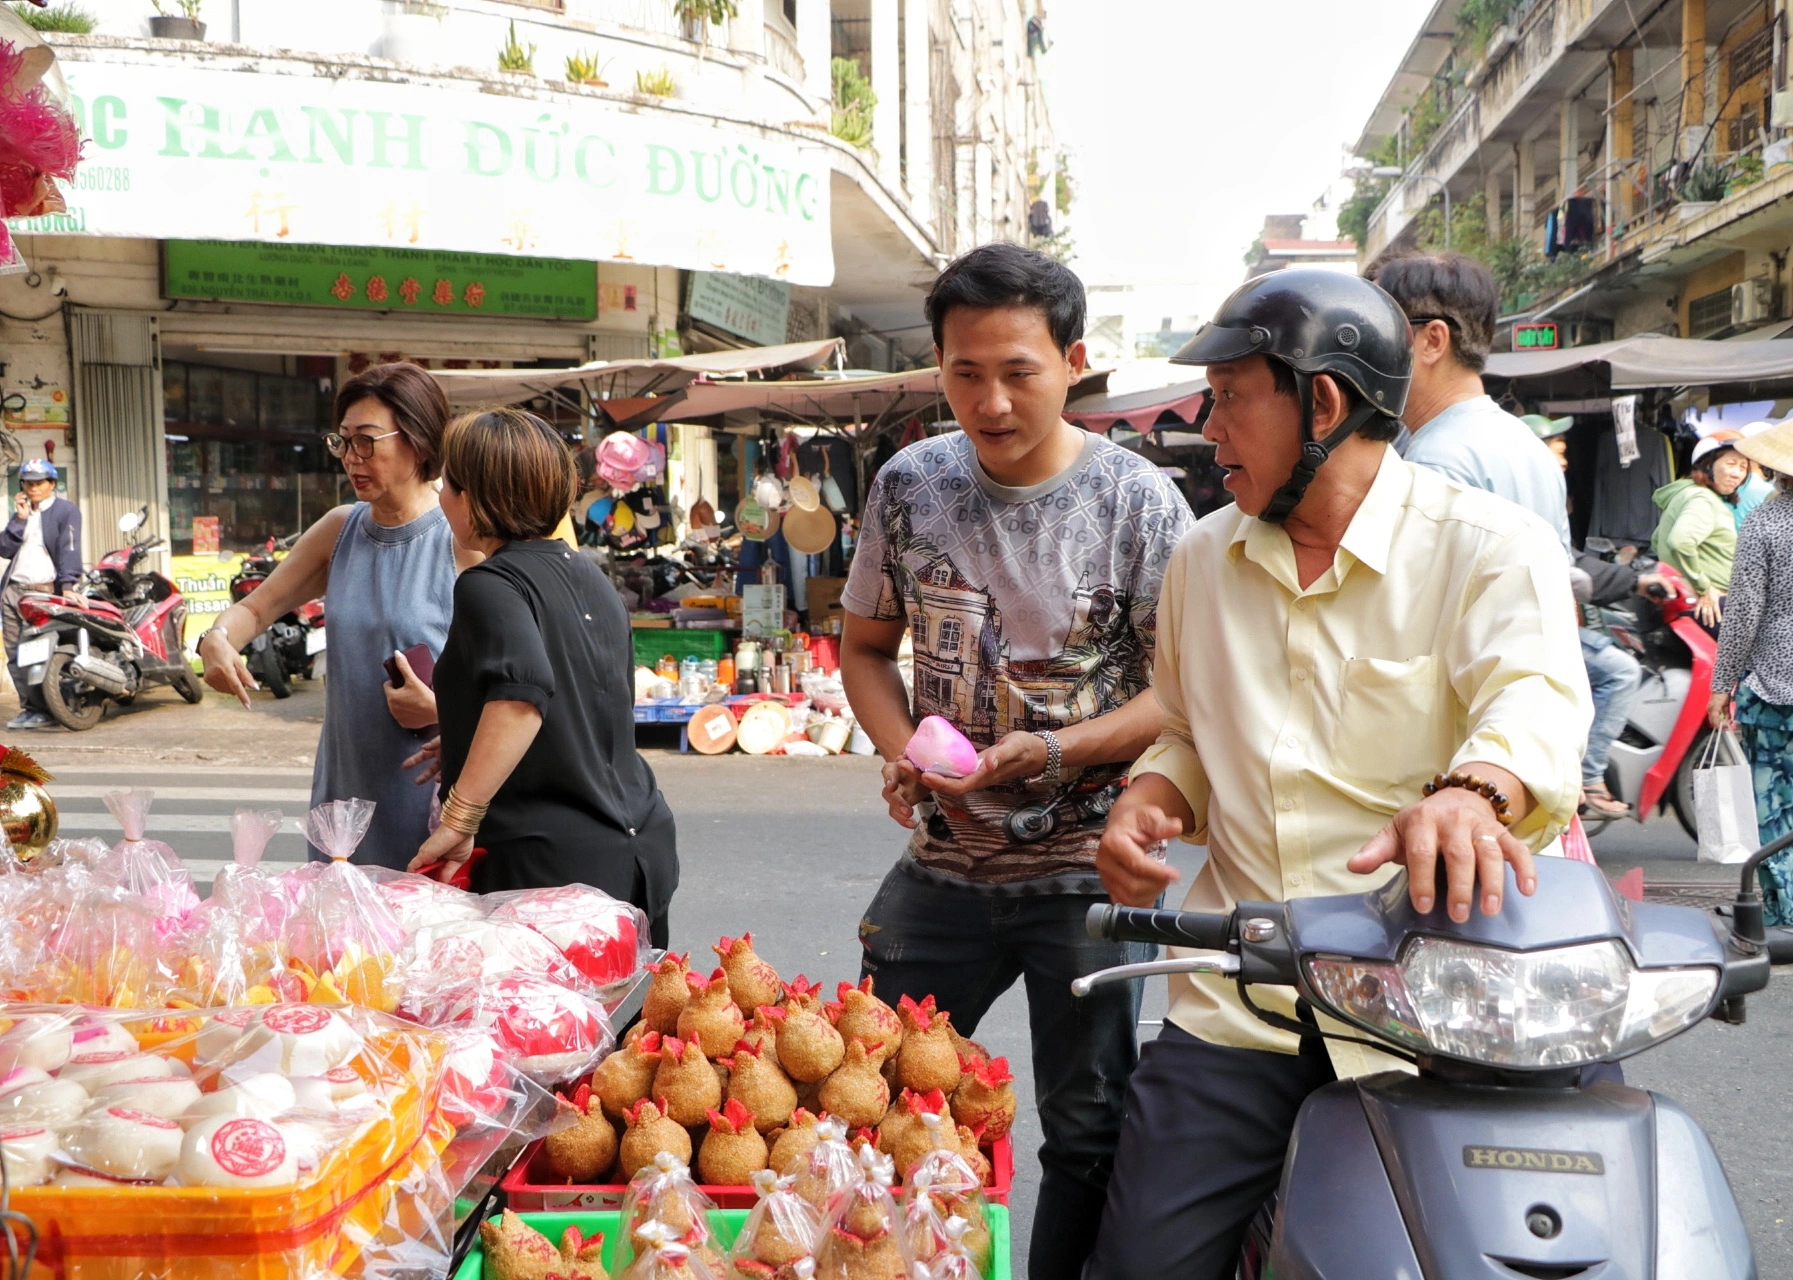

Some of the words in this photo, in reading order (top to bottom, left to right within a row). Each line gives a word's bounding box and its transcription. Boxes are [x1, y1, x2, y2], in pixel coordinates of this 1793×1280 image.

[156, 96, 429, 178] HẠNH
[460, 112, 617, 189] ĐỨC
[644, 143, 819, 222] ĐƯỜNG
[923, 451, 947, 464] DG
[1113, 454, 1139, 468] DG
[939, 477, 962, 491] DG
[1079, 473, 1102, 489] DG
[1129, 481, 1155, 501] DG
[909, 502, 931, 516] DG
[1043, 494, 1069, 510] DG
[957, 508, 981, 523] DG
[1007, 519, 1034, 535] DG
[1061, 526, 1088, 544] DG
[975, 541, 998, 557] DG
[1028, 551, 1053, 566] DG
[1085, 561, 1109, 578] DG
[997, 576, 1018, 590] DG
[186, 599, 231, 614] issan
[1470, 1147, 1598, 1171] HONDA
